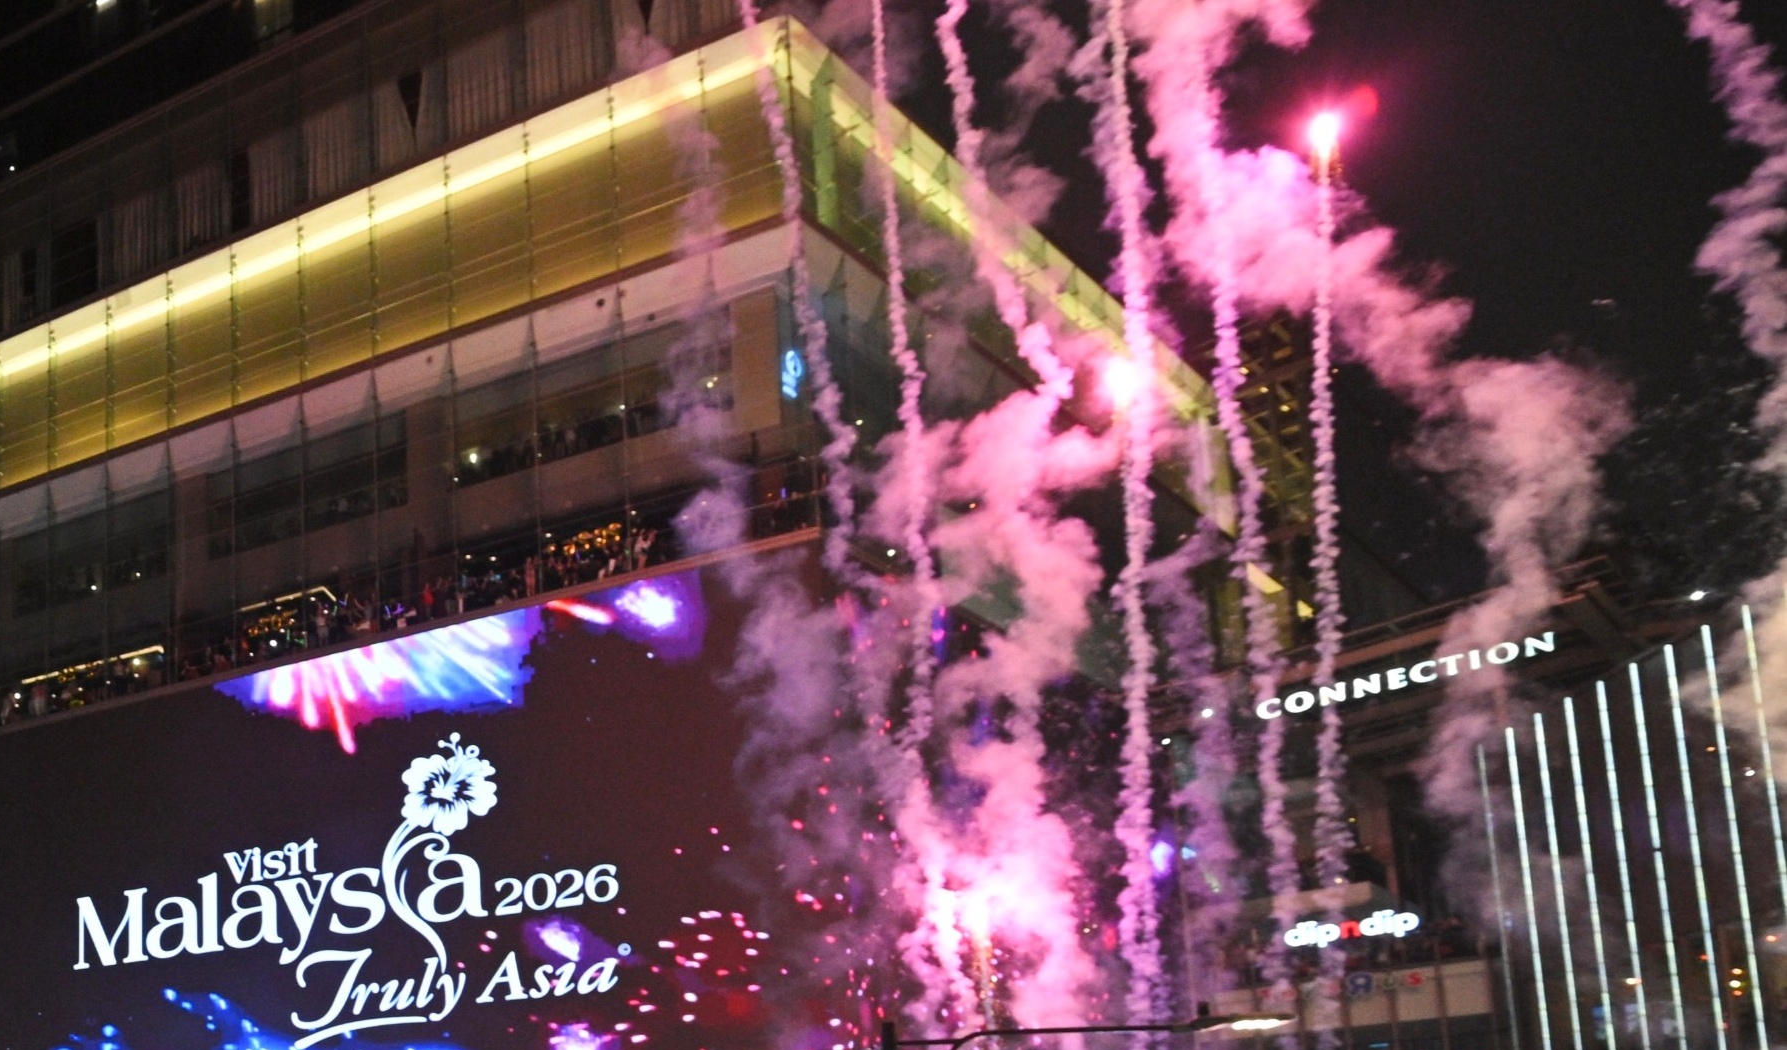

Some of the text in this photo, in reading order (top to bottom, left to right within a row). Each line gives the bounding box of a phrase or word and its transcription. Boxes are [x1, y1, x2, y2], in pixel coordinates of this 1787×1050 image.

[1255, 631, 1558, 720] CONNECTION
[72, 832, 620, 971] Malaysia 2026
[1283, 908, 1420, 947] dipndip
[290, 945, 620, 1048] Truly Asia
